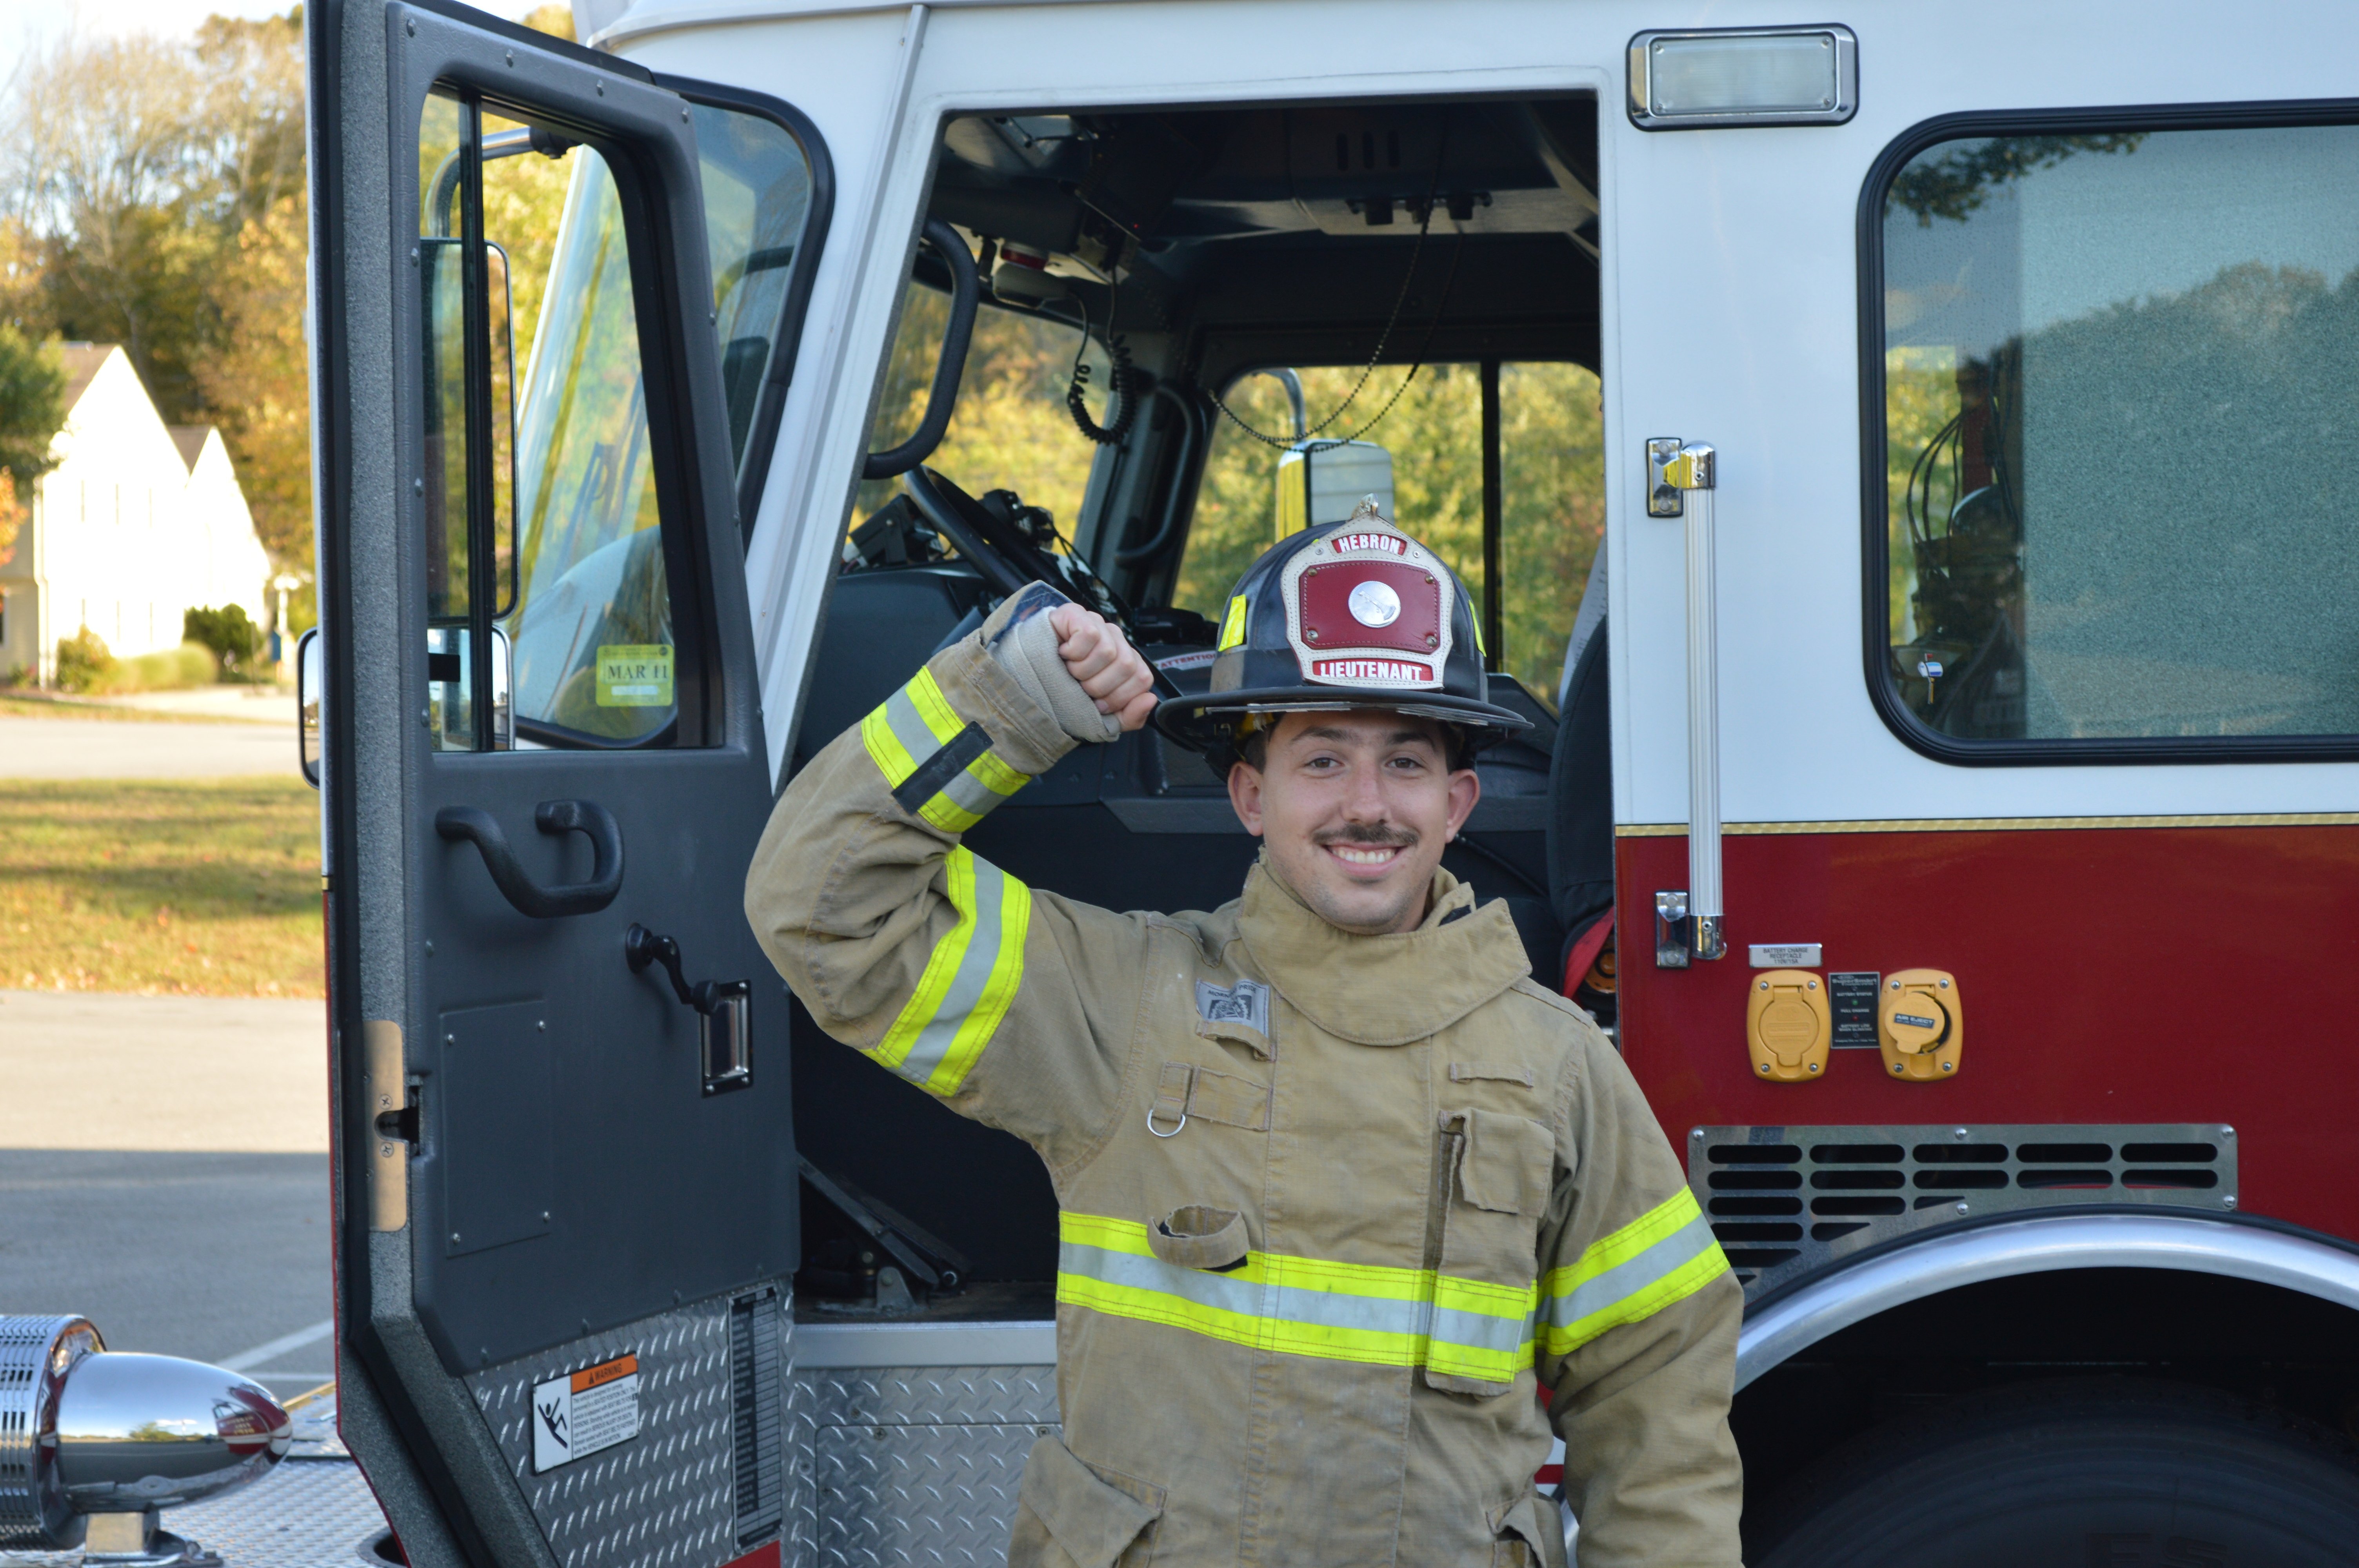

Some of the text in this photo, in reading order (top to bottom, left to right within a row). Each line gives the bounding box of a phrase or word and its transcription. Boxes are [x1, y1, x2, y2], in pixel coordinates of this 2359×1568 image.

[1338, 534, 1401, 553] HEBRON
[1161, 654, 1215, 668] ATTENTIO
[608, 665, 646, 679] MAR
[1320, 661, 1422, 681] LIEUTENANT
[1239, 984, 1256, 994] PRIDE
[595, 1363, 622, 1381] WARNING
